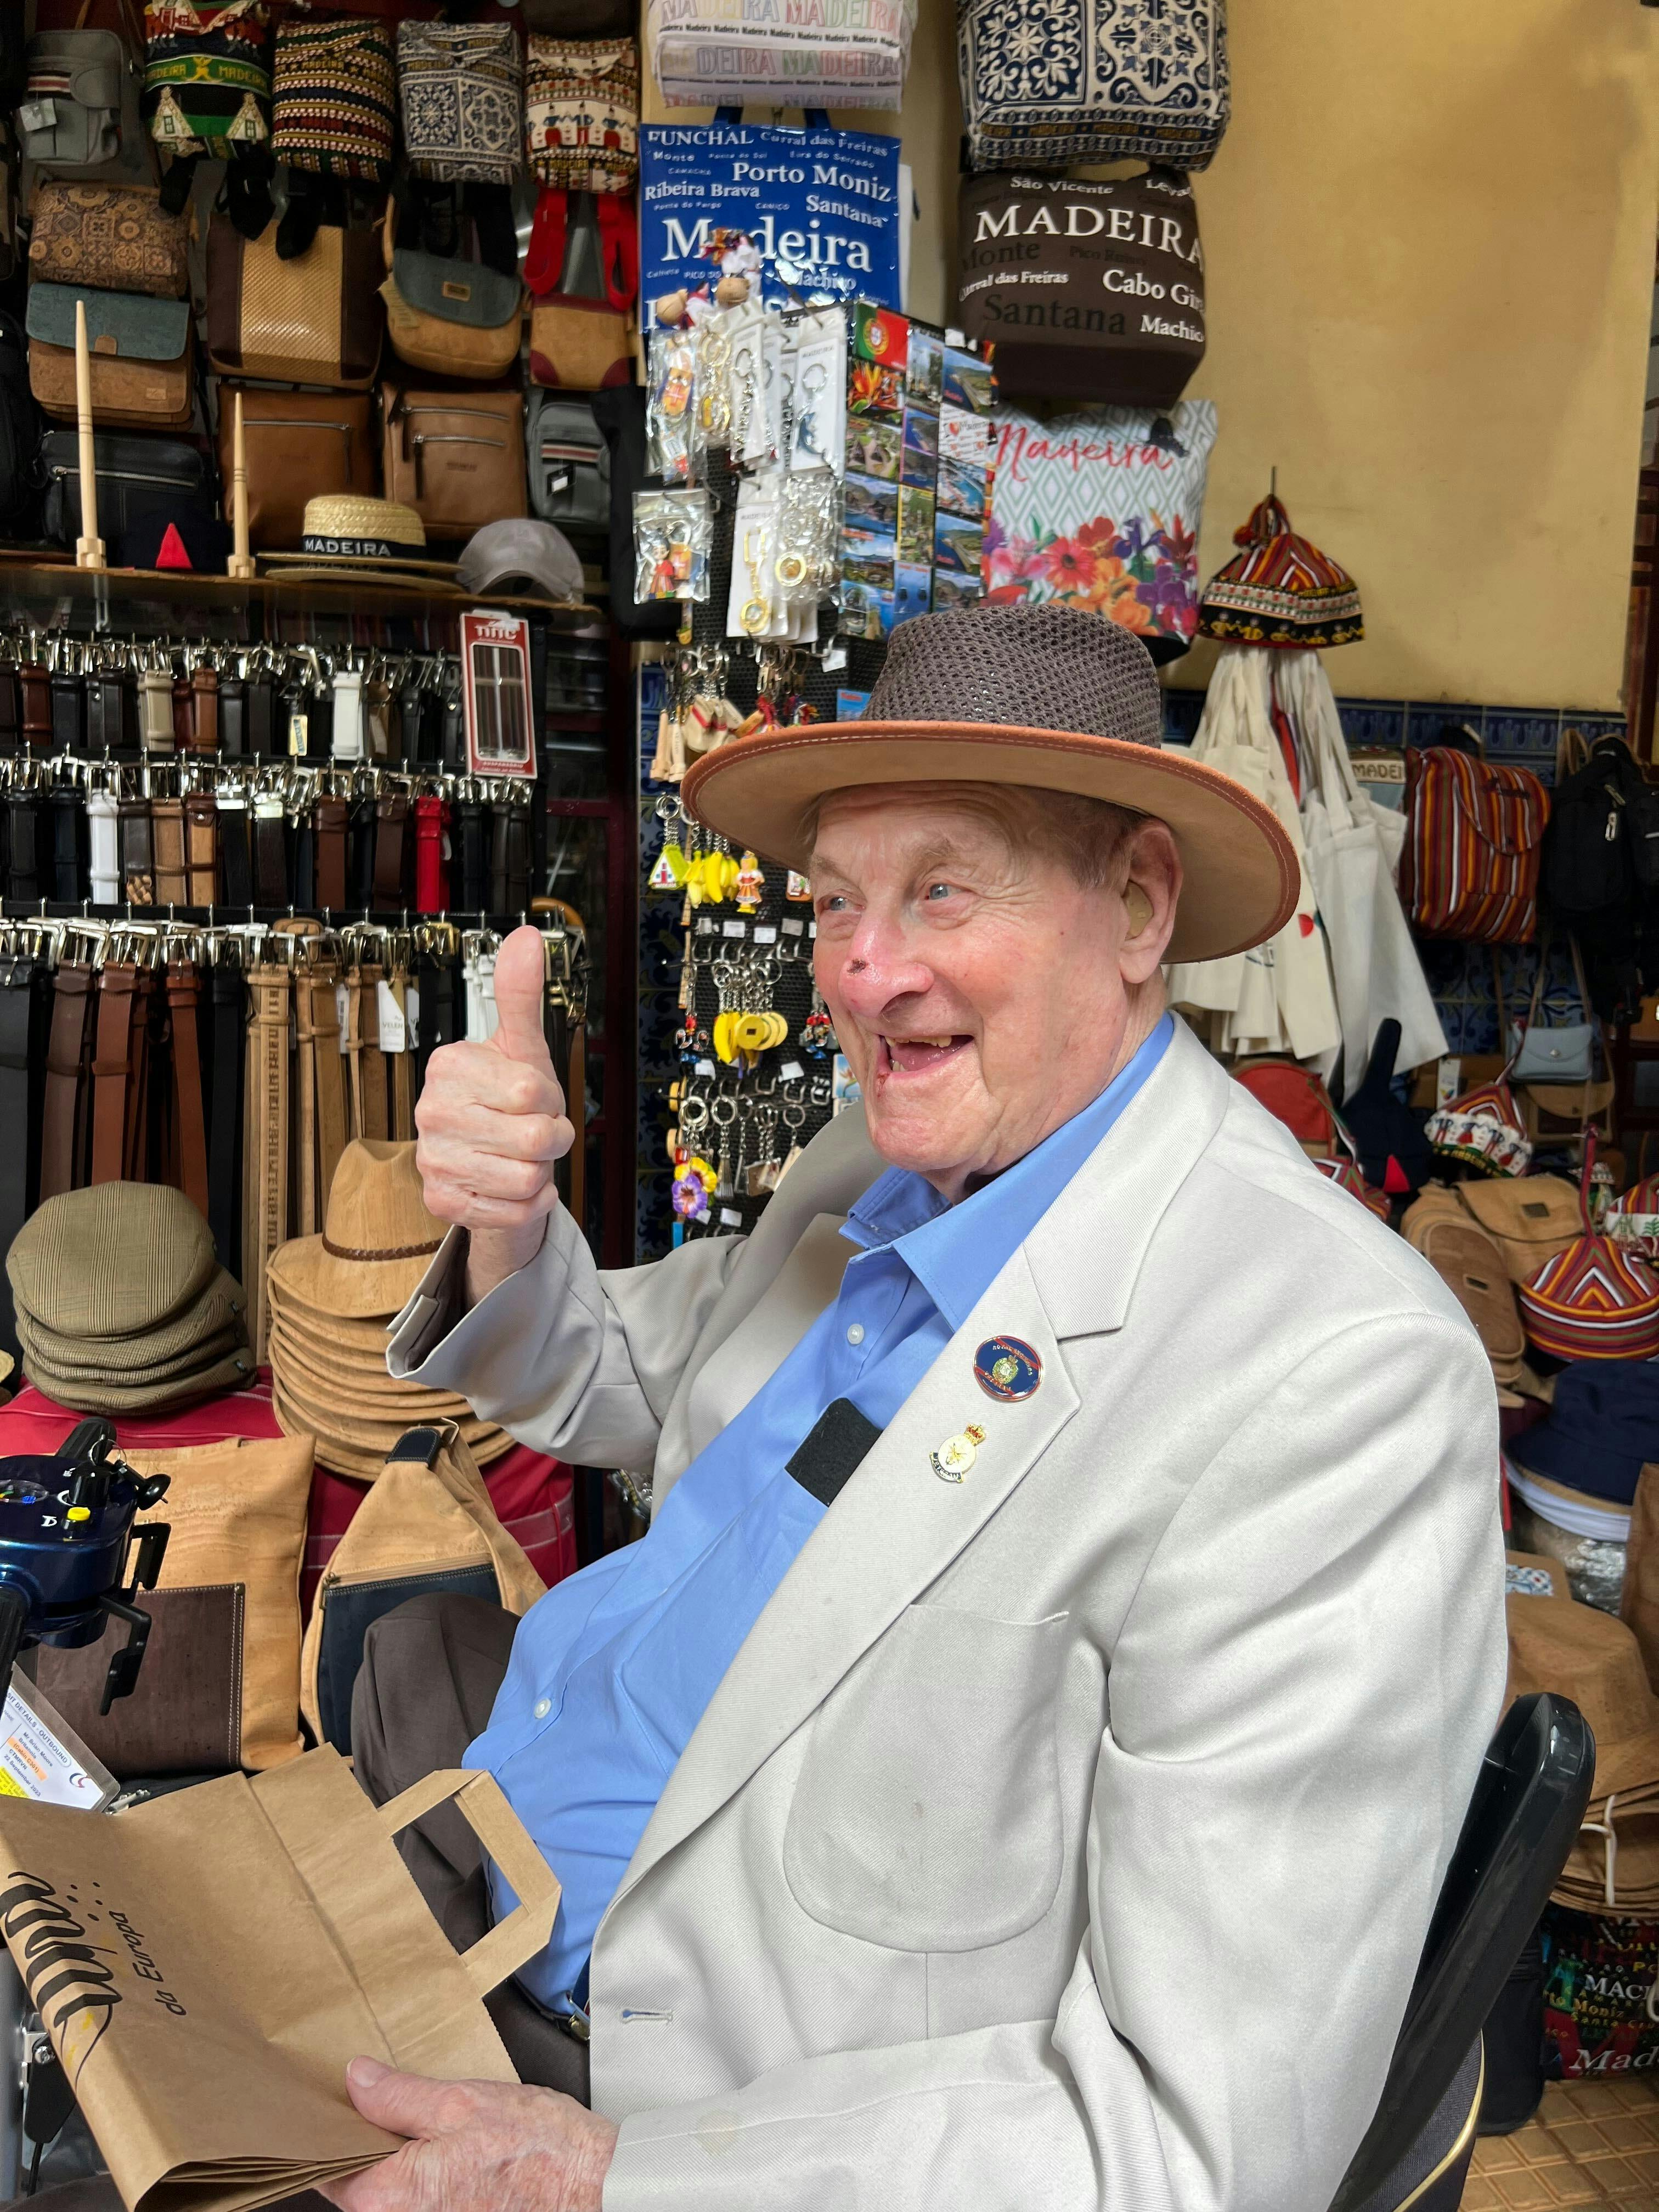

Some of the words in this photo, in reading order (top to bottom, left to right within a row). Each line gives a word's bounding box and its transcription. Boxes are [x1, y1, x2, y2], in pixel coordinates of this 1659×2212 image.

[810, 135, 836, 146] das
[645, 180, 705, 201] Ribeira
[710, 183, 761, 198] Brava
[732, 162, 805, 183] Porto
[811, 165, 893, 203] Moniz
[1011, 176, 1043, 190] São
[1047, 181, 1115, 195] Vicente
[806, 194, 883, 229] Santana
[661, 215, 873, 273] Mdeira
[973, 205, 1205, 273] MADEIRA
[995, 272, 1019, 285] das
[1103, 269, 1165, 300] Cabo
[984, 294, 1126, 335] Santana
[303, 538, 391, 557] MADEIRA
[15, 1702, 37, 1728] DETAILS
[39, 1730, 67, 1764] OUTBOUND
[30, 1738, 41, 1753] Brian
[40, 1751, 53, 1767] Moore
[9, 1759, 31, 1786] September
[109, 1910, 164, 1982] Europa
[154, 1989, 187, 2016] da
